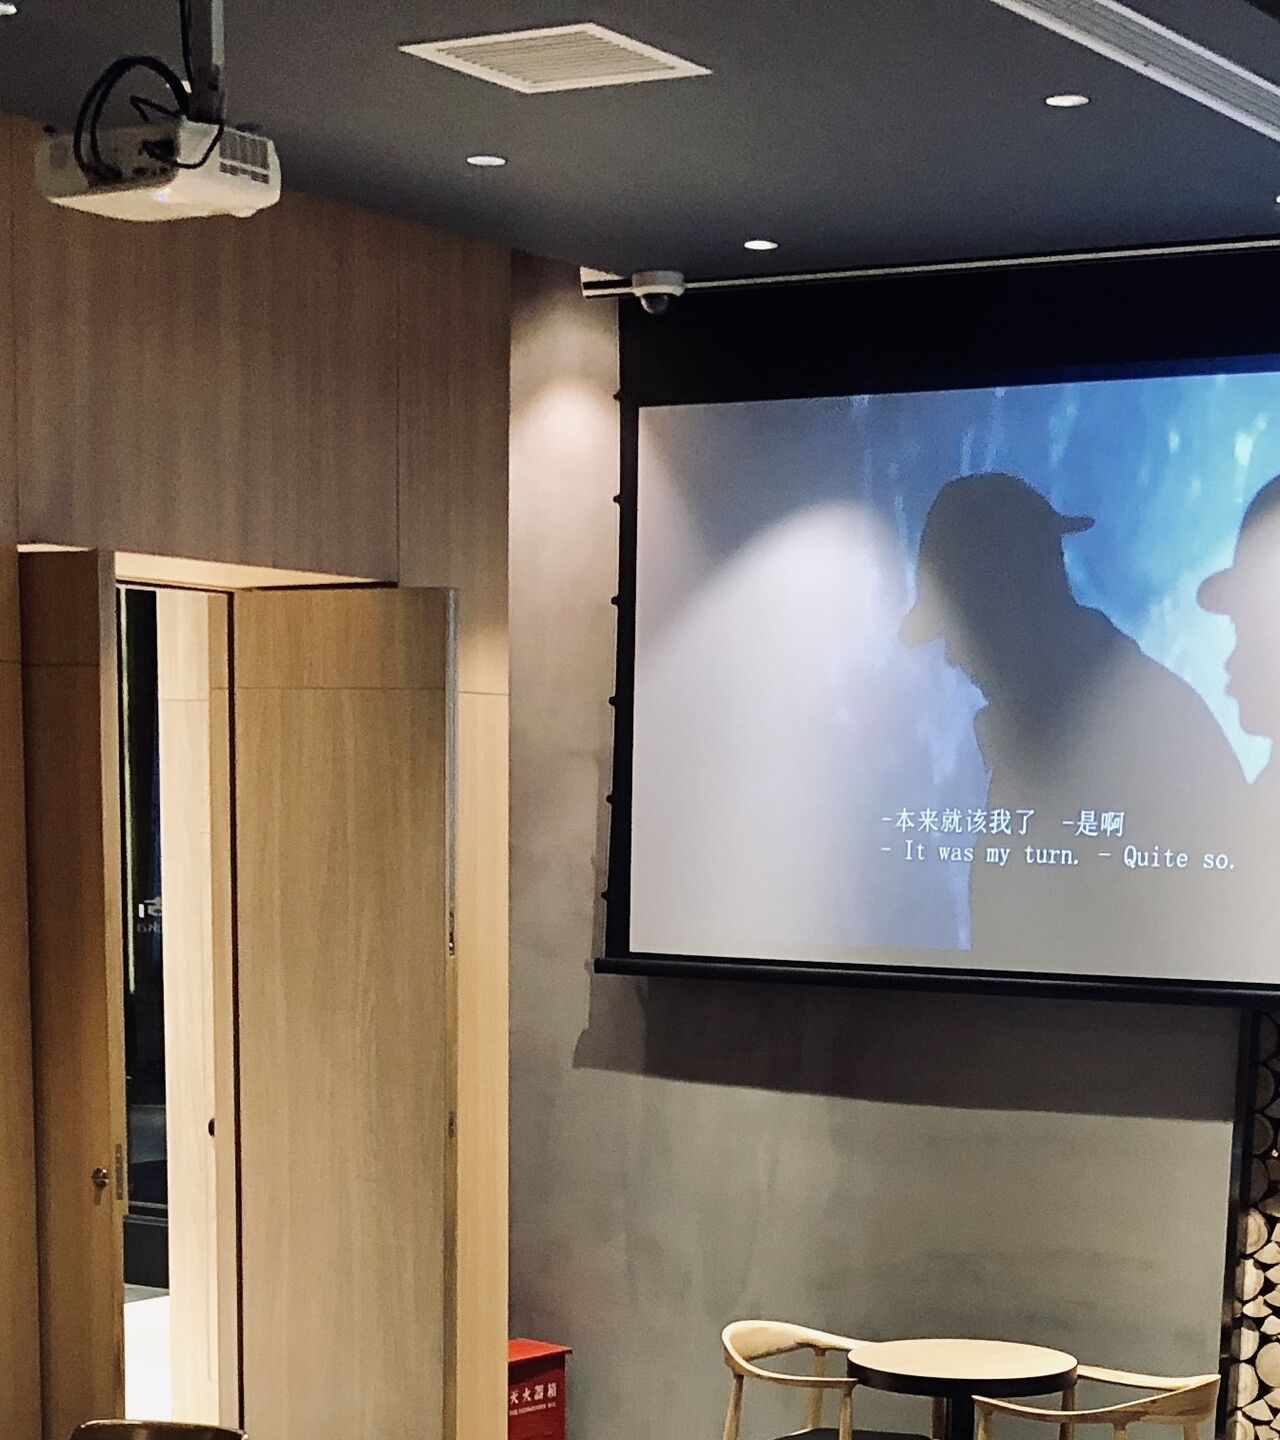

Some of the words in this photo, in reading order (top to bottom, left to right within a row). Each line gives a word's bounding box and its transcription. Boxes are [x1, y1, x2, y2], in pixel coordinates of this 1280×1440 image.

[904, 839, 925, 861] It
[939, 844, 974, 862] was
[986, 845, 1011, 866] my
[1025, 844, 1079, 865] turn.
[1124, 845, 1188, 869] Quite
[1203, 852, 1235, 870] so.
